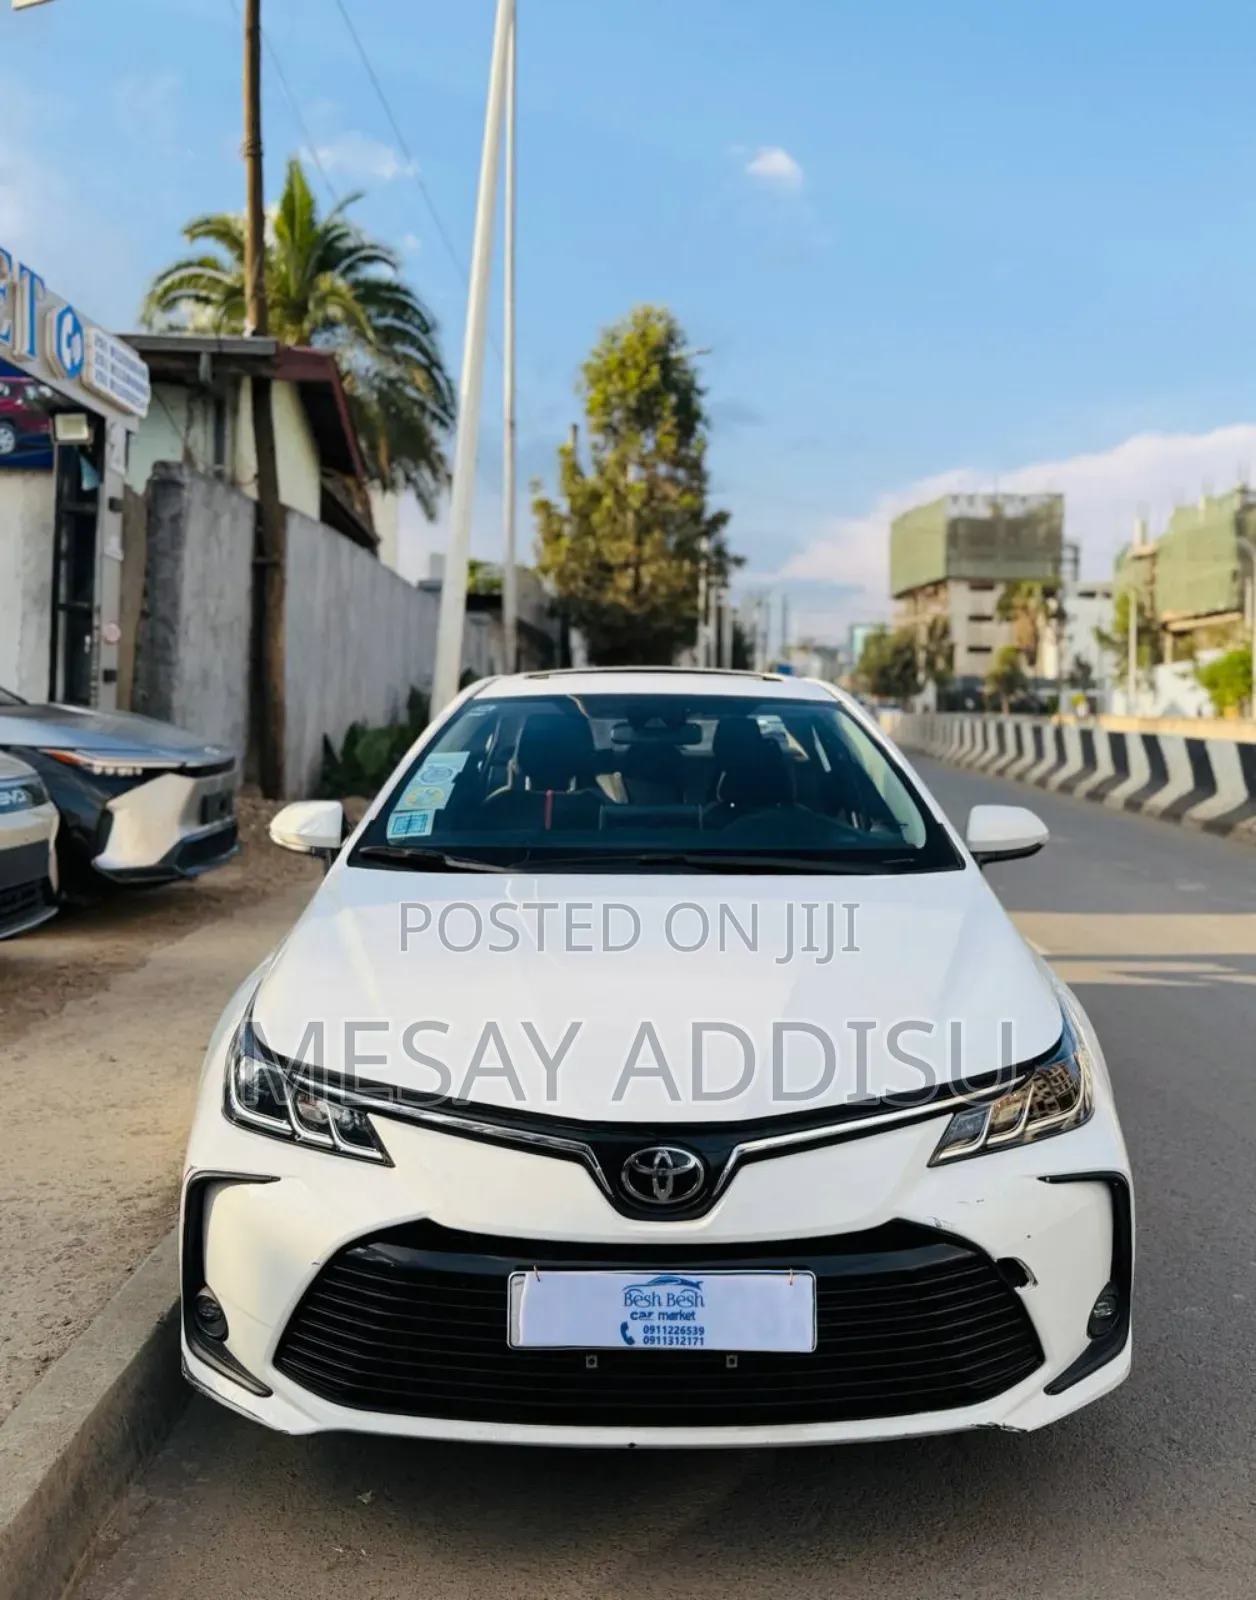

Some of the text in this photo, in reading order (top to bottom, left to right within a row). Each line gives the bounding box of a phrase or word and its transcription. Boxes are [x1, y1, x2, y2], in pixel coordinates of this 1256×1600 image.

[624, 1291, 704, 1308] Besh Besh
[630, 1310, 696, 1321] car market
[643, 1325, 705, 1336] 0911226539
[643, 1336, 704, 1345] 0911312171
